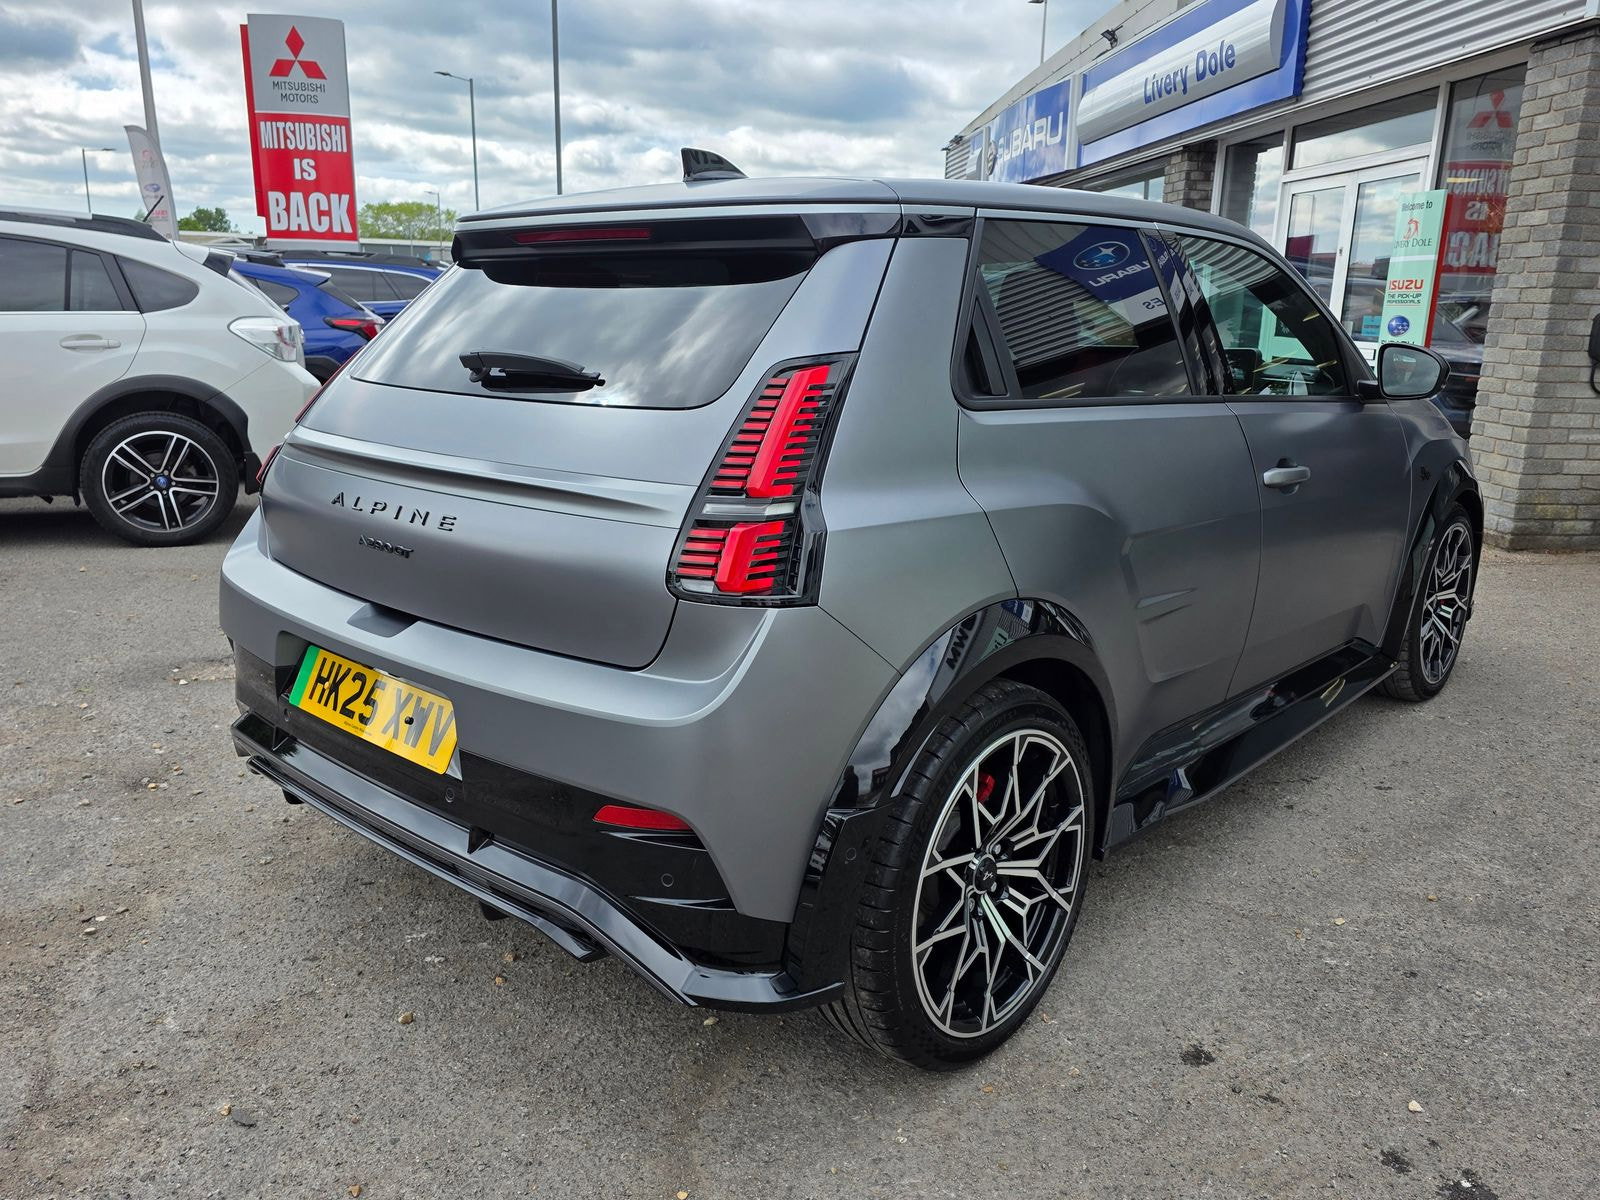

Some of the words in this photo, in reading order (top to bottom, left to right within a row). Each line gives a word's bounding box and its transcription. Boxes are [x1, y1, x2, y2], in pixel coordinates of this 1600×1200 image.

[272, 80, 326, 94] MITSUBISHI
[1143, 65, 1188, 104] Livery
[1195, 40, 1236, 82] Dole
[280, 92, 319, 105] MOTORS
[259, 120, 348, 153] MITSUBISHI
[997, 112, 1064, 161] SUBARU
[293, 158, 317, 181] IS
[267, 191, 353, 234] BACK
[1411, 238, 1432, 247] DOLE
[1388, 279, 1424, 291] ISUZU
[331, 491, 457, 532] ALPINE
[308, 656, 387, 727] HK25
[381, 687, 455, 758] XWV
